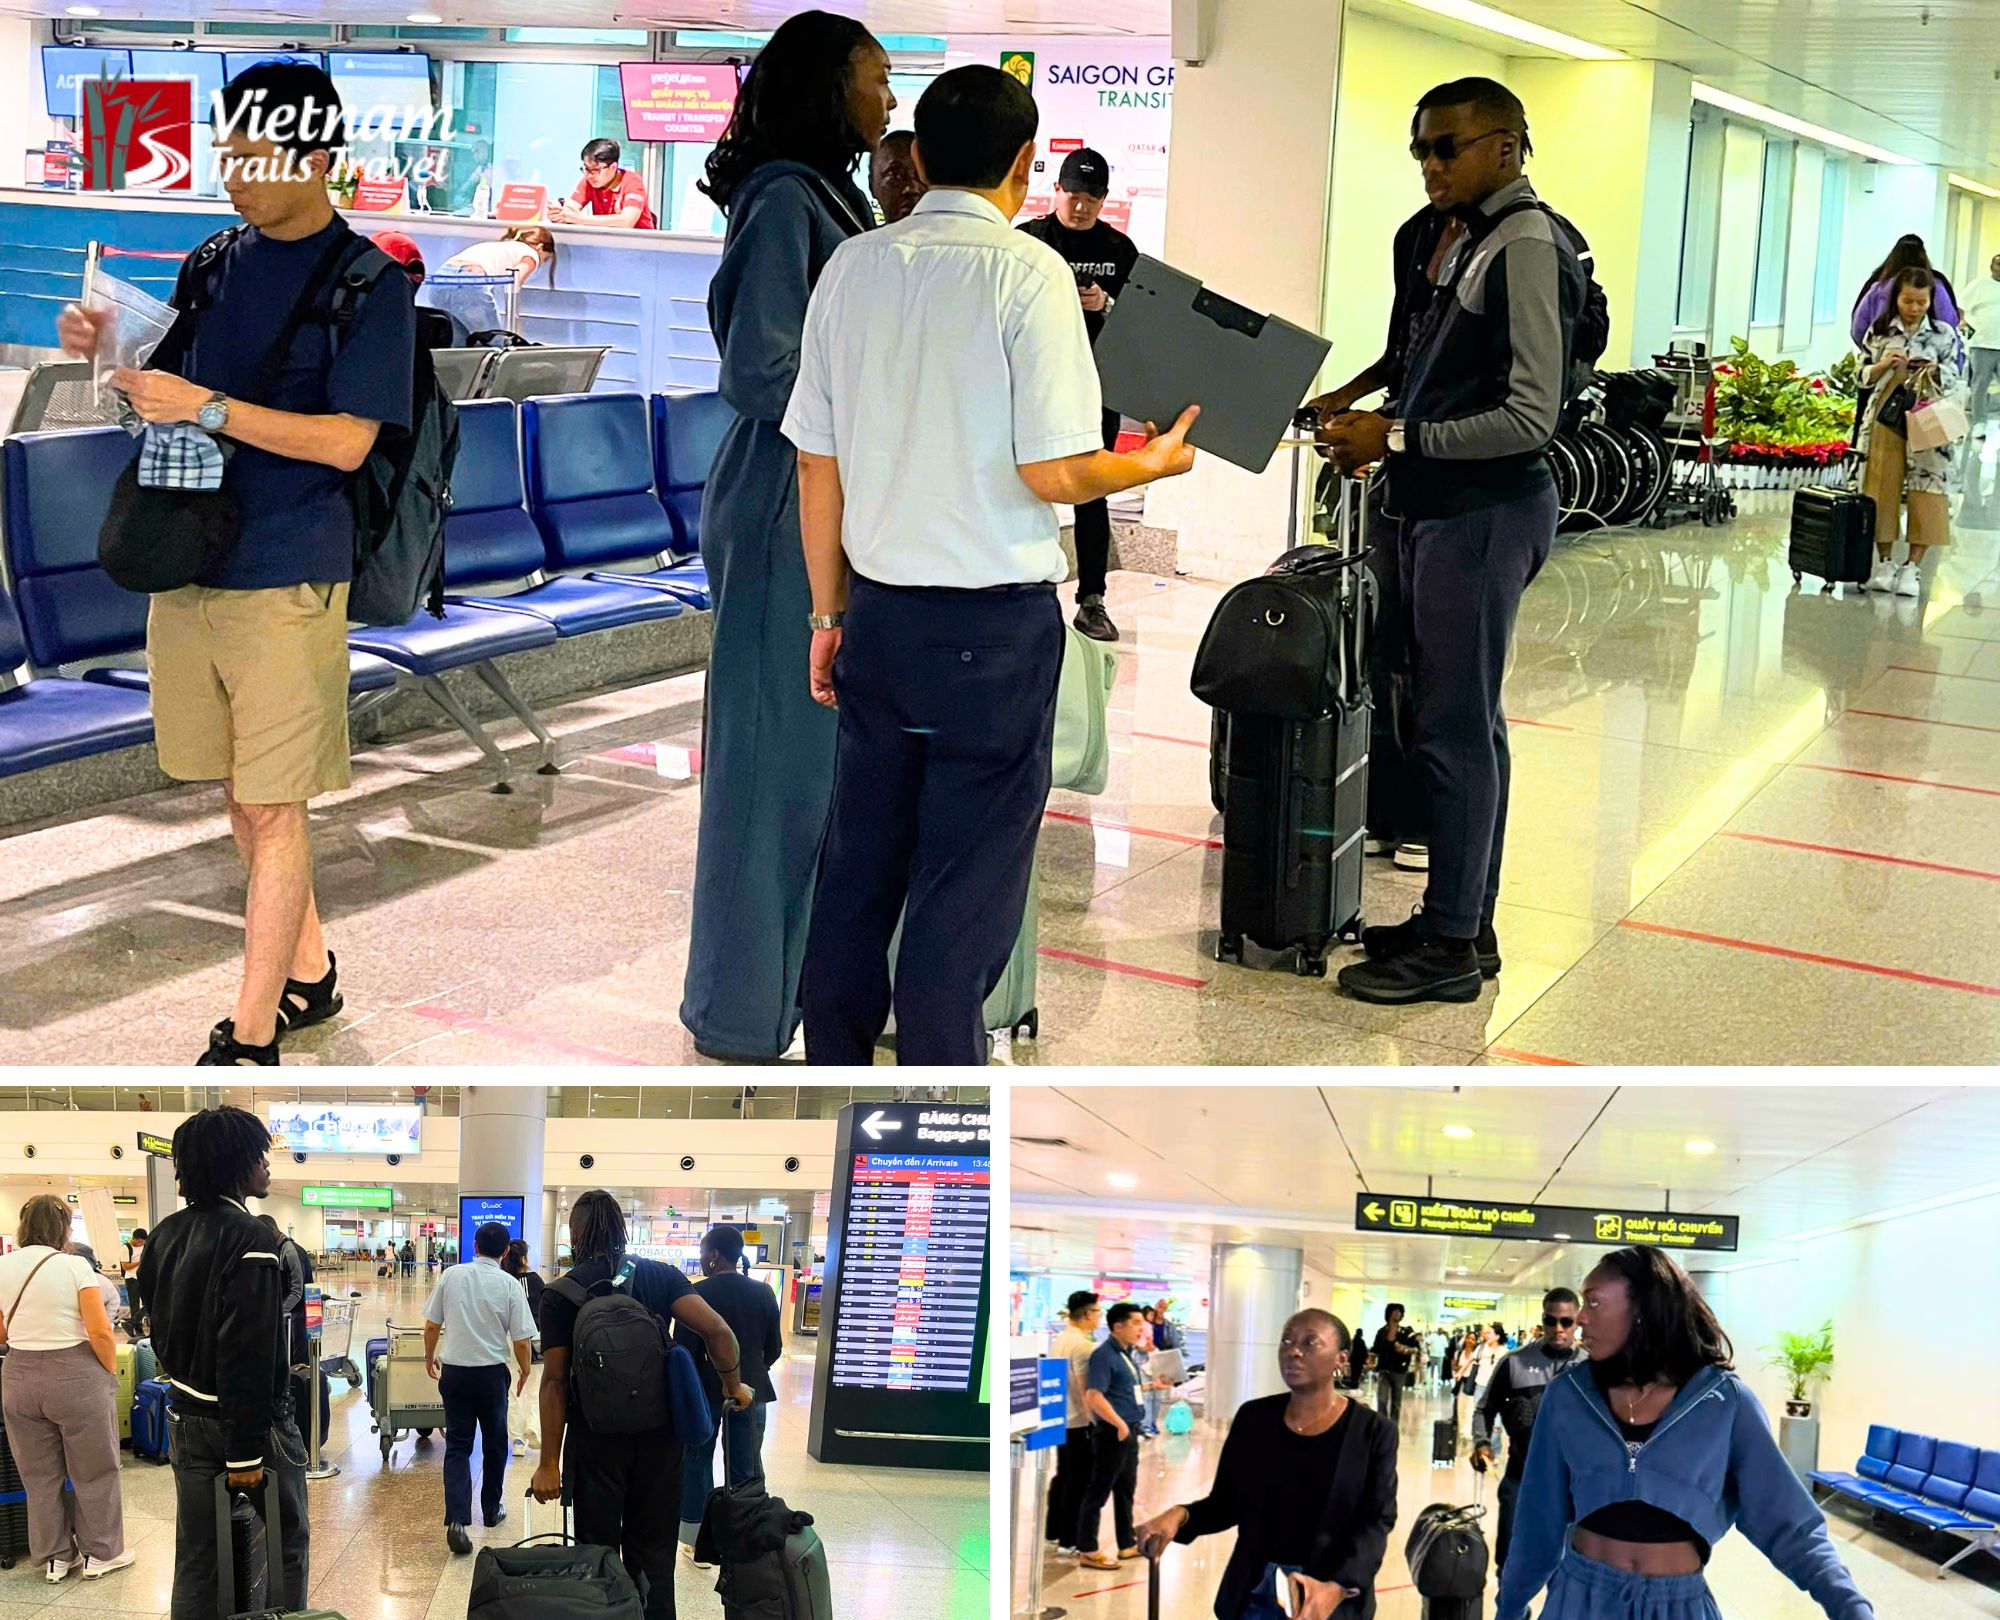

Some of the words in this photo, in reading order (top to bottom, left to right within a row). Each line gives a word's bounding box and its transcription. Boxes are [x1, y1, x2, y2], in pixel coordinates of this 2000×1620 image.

[1048, 65, 1138, 85] SAIGON
[919, 1111, 959, 1125] BĂNG
[917, 1127, 976, 1142] Baggage
[926, 1159, 958, 1167] Arrivals
[633, 1246, 683, 1258] TOBACCO
